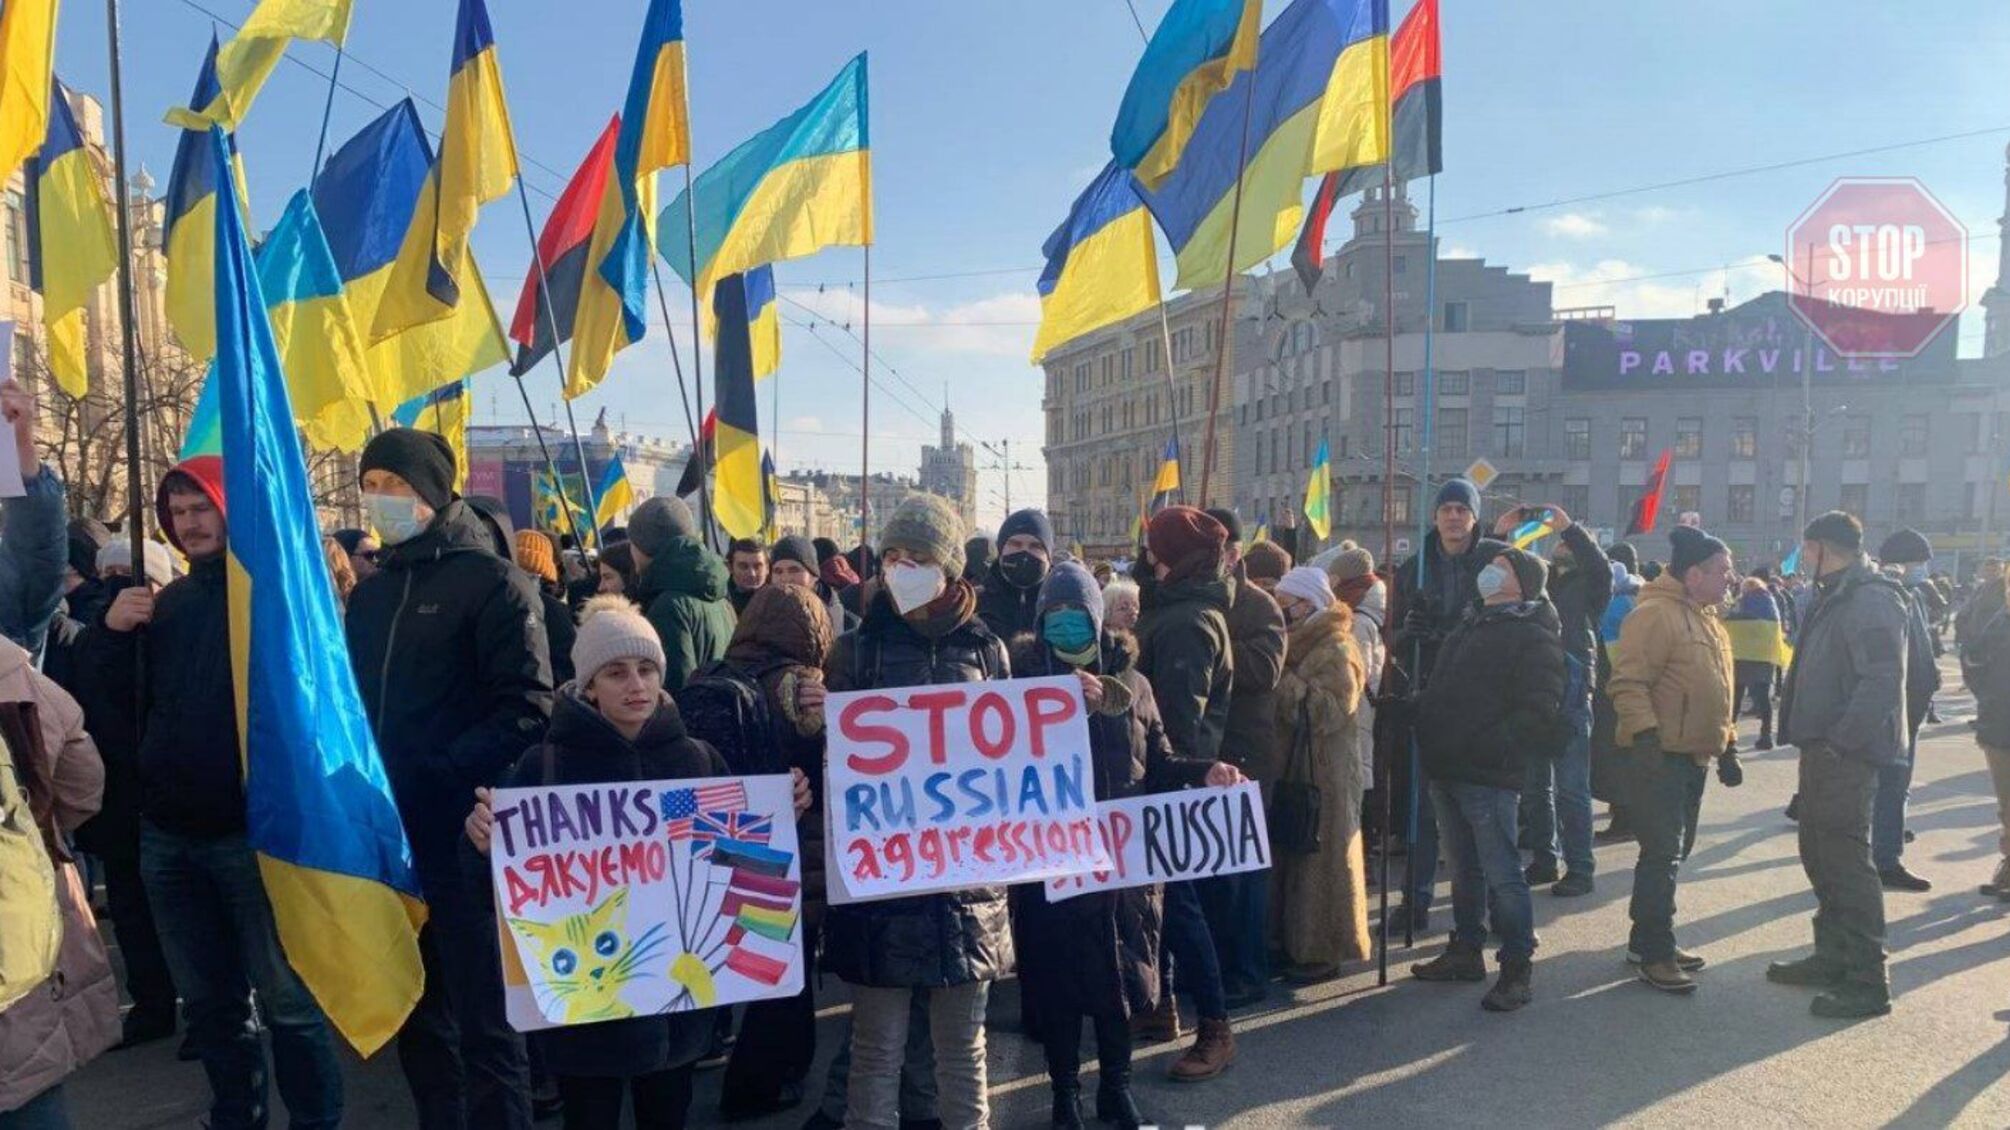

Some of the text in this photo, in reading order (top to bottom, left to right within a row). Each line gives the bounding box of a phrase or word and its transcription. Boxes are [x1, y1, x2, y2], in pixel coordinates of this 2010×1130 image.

[1619, 349, 1900, 375] PARKVILLE
[839, 687, 1078, 776] STOP
[494, 787, 658, 857] THANKS
[844, 754, 1086, 832] RUSSIAN
[846, 817, 1094, 882] aggression
[1142, 791, 1265, 877] RUSSIA
